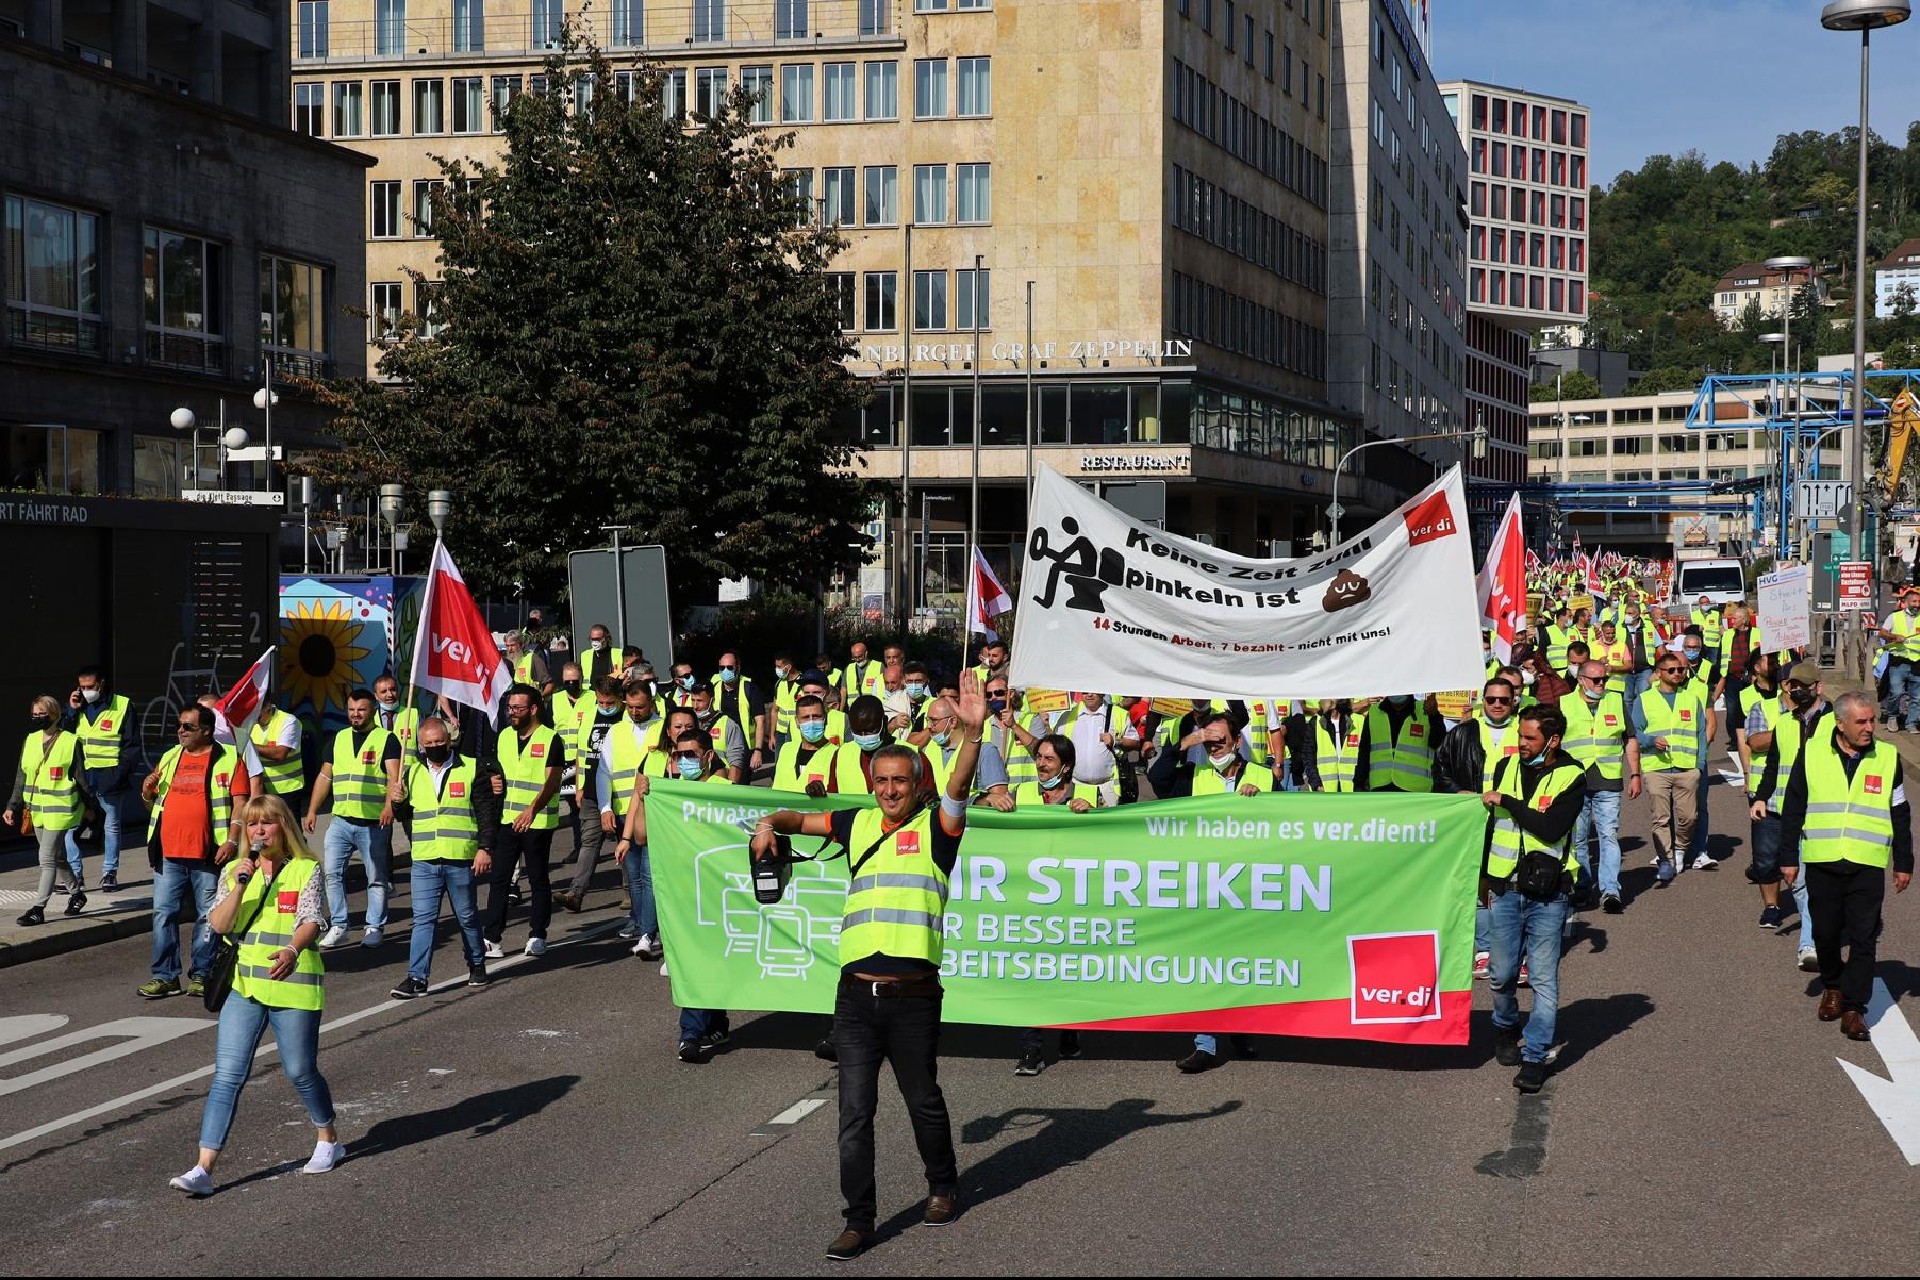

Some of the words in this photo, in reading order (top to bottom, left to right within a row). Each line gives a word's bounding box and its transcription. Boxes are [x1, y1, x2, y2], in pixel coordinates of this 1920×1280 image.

[991, 342, 1057, 360] GRAF
[1070, 340, 1193, 358] ZEPPELIN
[1080, 454, 1189, 469] RESTAURANT
[19, 500, 60, 521] FÄHRT
[62, 505, 88, 523] RAD
[226, 493, 253, 502] Passage
[1125, 527, 1220, 574] Keine
[1228, 566, 1298, 581] Zeit
[1125, 567, 1244, 608] pinkeln
[1255, 587, 1301, 609] ist
[1759, 575, 1778, 586] HVG
[250, 611, 261, 643] 2
[1093, 616, 1110, 630] 14
[1112, 620, 1168, 641] Stunden
[1221, 642, 1228, 651] 7
[1234, 642, 1285, 652] bezahlt
[1297, 636, 1332, 650] nicht
[1336, 632, 1358, 645] mit
[1361, 626, 1391, 641] uns!
[1145, 816, 1188, 837] Wir
[1196, 815, 1270, 840] haben
[1278, 820, 1304, 841] es
[1313, 817, 1437, 843] ver.dient!
[1027, 857, 1332, 912] STREIKEN
[977, 914, 1136, 945] BESSERE
[939, 949, 1300, 987] BEITSBEDINGUNGEN
[1361, 986, 1431, 1007] ver.di
